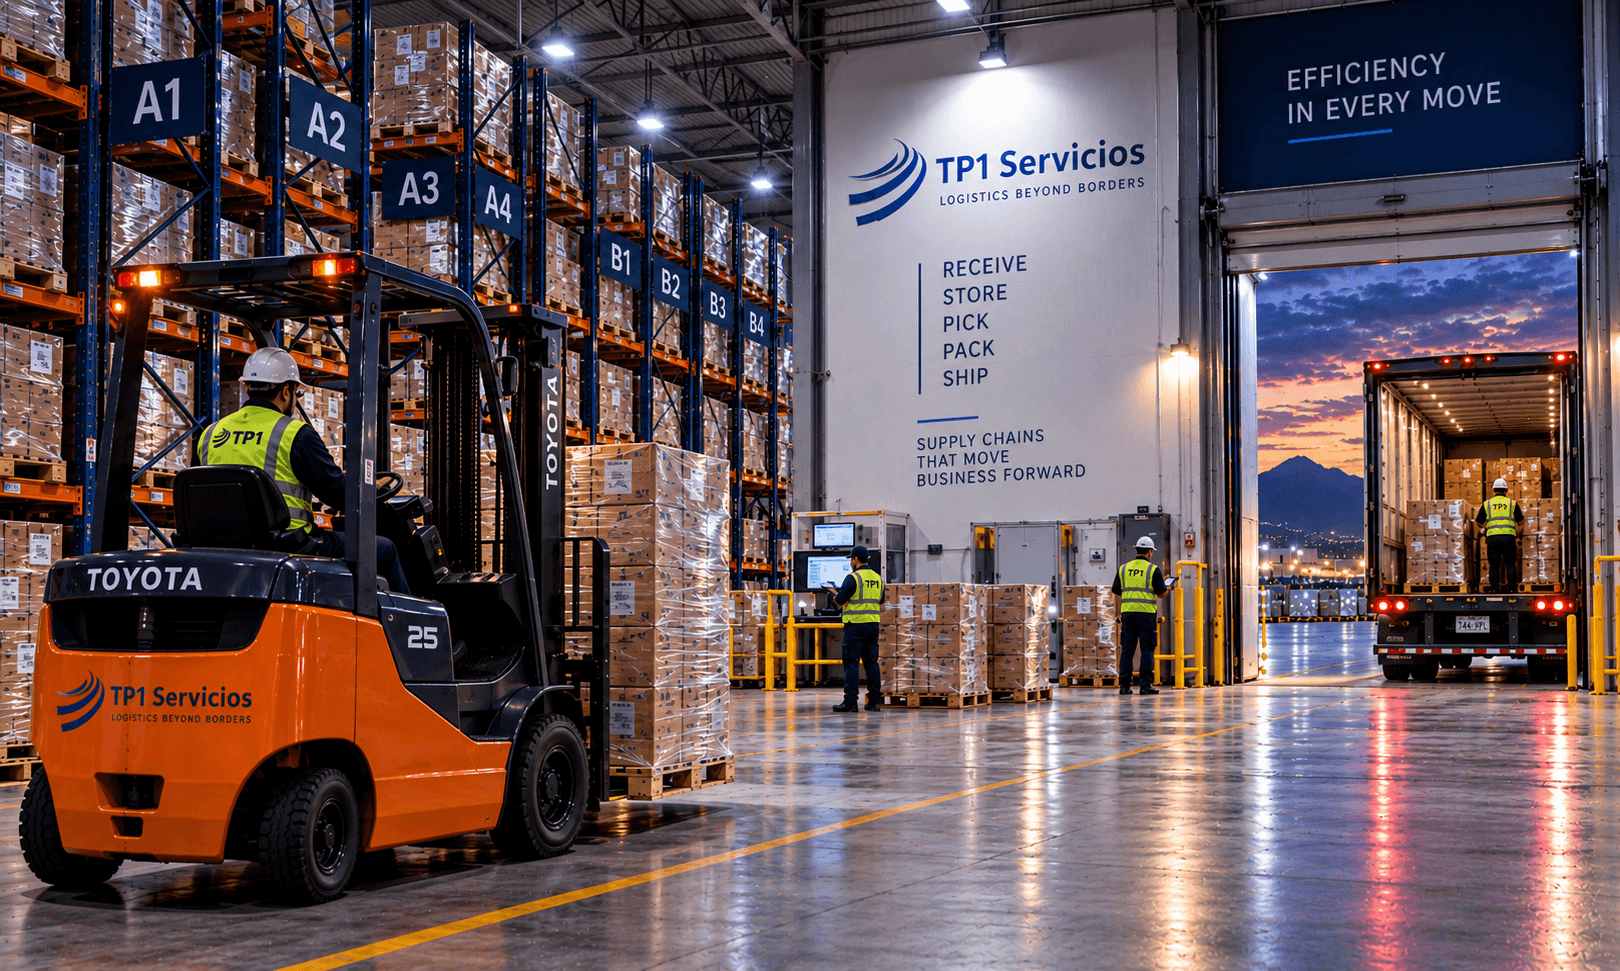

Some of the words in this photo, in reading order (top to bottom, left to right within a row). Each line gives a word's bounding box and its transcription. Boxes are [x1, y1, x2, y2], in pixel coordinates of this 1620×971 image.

[1287, 51, 1446, 91] EFFICIENCY
[132, 77, 180, 125] A1
[1288, 101, 1313, 124] IN
[1326, 90, 1411, 120] EVERY
[1423, 81, 1502, 111] MOVE
[306, 101, 346, 153] A2
[935, 153, 988, 184] TP1
[999, 138, 1145, 178] Servicios
[398, 170, 440, 206] A3
[939, 189, 1009, 206] LOGISTICS
[1015, 184, 1071, 199] BEYOND
[1078, 177, 1145, 193] BORDERS
[484, 184, 512, 224] A4
[611, 242, 630, 276] B1
[943, 254, 1027, 278] RECEIVE
[661, 267, 681, 300] B2
[943, 283, 1007, 306] STORE
[710, 291, 726, 319] B3
[749, 310, 765, 338] B4
[943, 312, 989, 333] PICK
[943, 339, 995, 360] PACK
[943, 367, 988, 387] SHIP
[232, 430, 264, 446] TP1
[546, 375, 558, 490] TOYOTA
[917, 434, 976, 451] SUPPLY
[982, 428, 1045, 446] CHAINS
[916, 453, 957, 469] THAT
[964, 449, 1010, 466] MOVE
[917, 469, 997, 487] BUSINESS
[1003, 463, 1086, 482] FORWARD
[87, 566, 203, 591] TOYOTA
[865, 580, 879, 589] TP1
[407, 625, 438, 649] 25
[110, 686, 145, 707] TP1
[152, 686, 253, 708] Servicios
[111, 713, 158, 723] LOGISTICS
[162, 714, 201, 723] BEYOND
[205, 714, 252, 724] BORDERS
